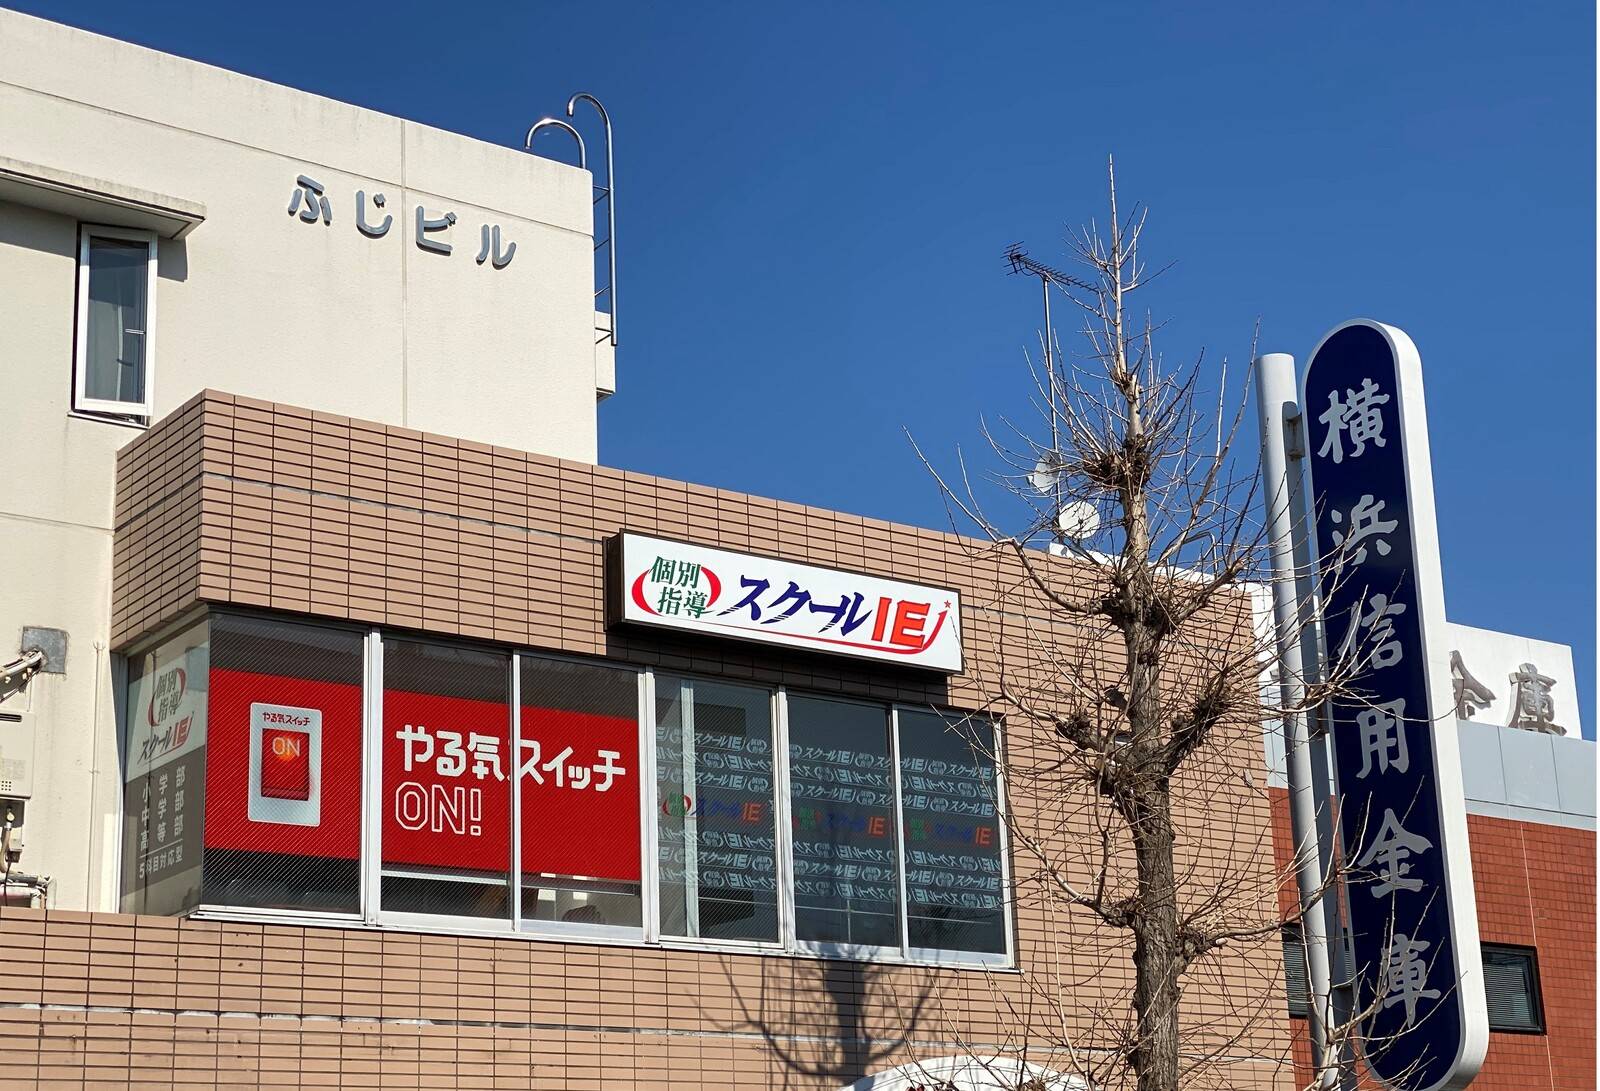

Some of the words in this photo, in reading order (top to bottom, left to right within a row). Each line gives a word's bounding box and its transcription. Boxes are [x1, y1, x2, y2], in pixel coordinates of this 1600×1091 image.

[287, 174, 517, 270] ふじビル
[648, 556, 702, 588] 個別
[657, 586, 716, 619] 指導
[262, 711, 311, 727] やる気スイッチ
[1317, 377, 1441, 1029] 横浜信用金庫
[272, 737, 300, 757] ON
[396, 724, 626, 792] やる気スイッチ
[395, 781, 482, 836] ON!
